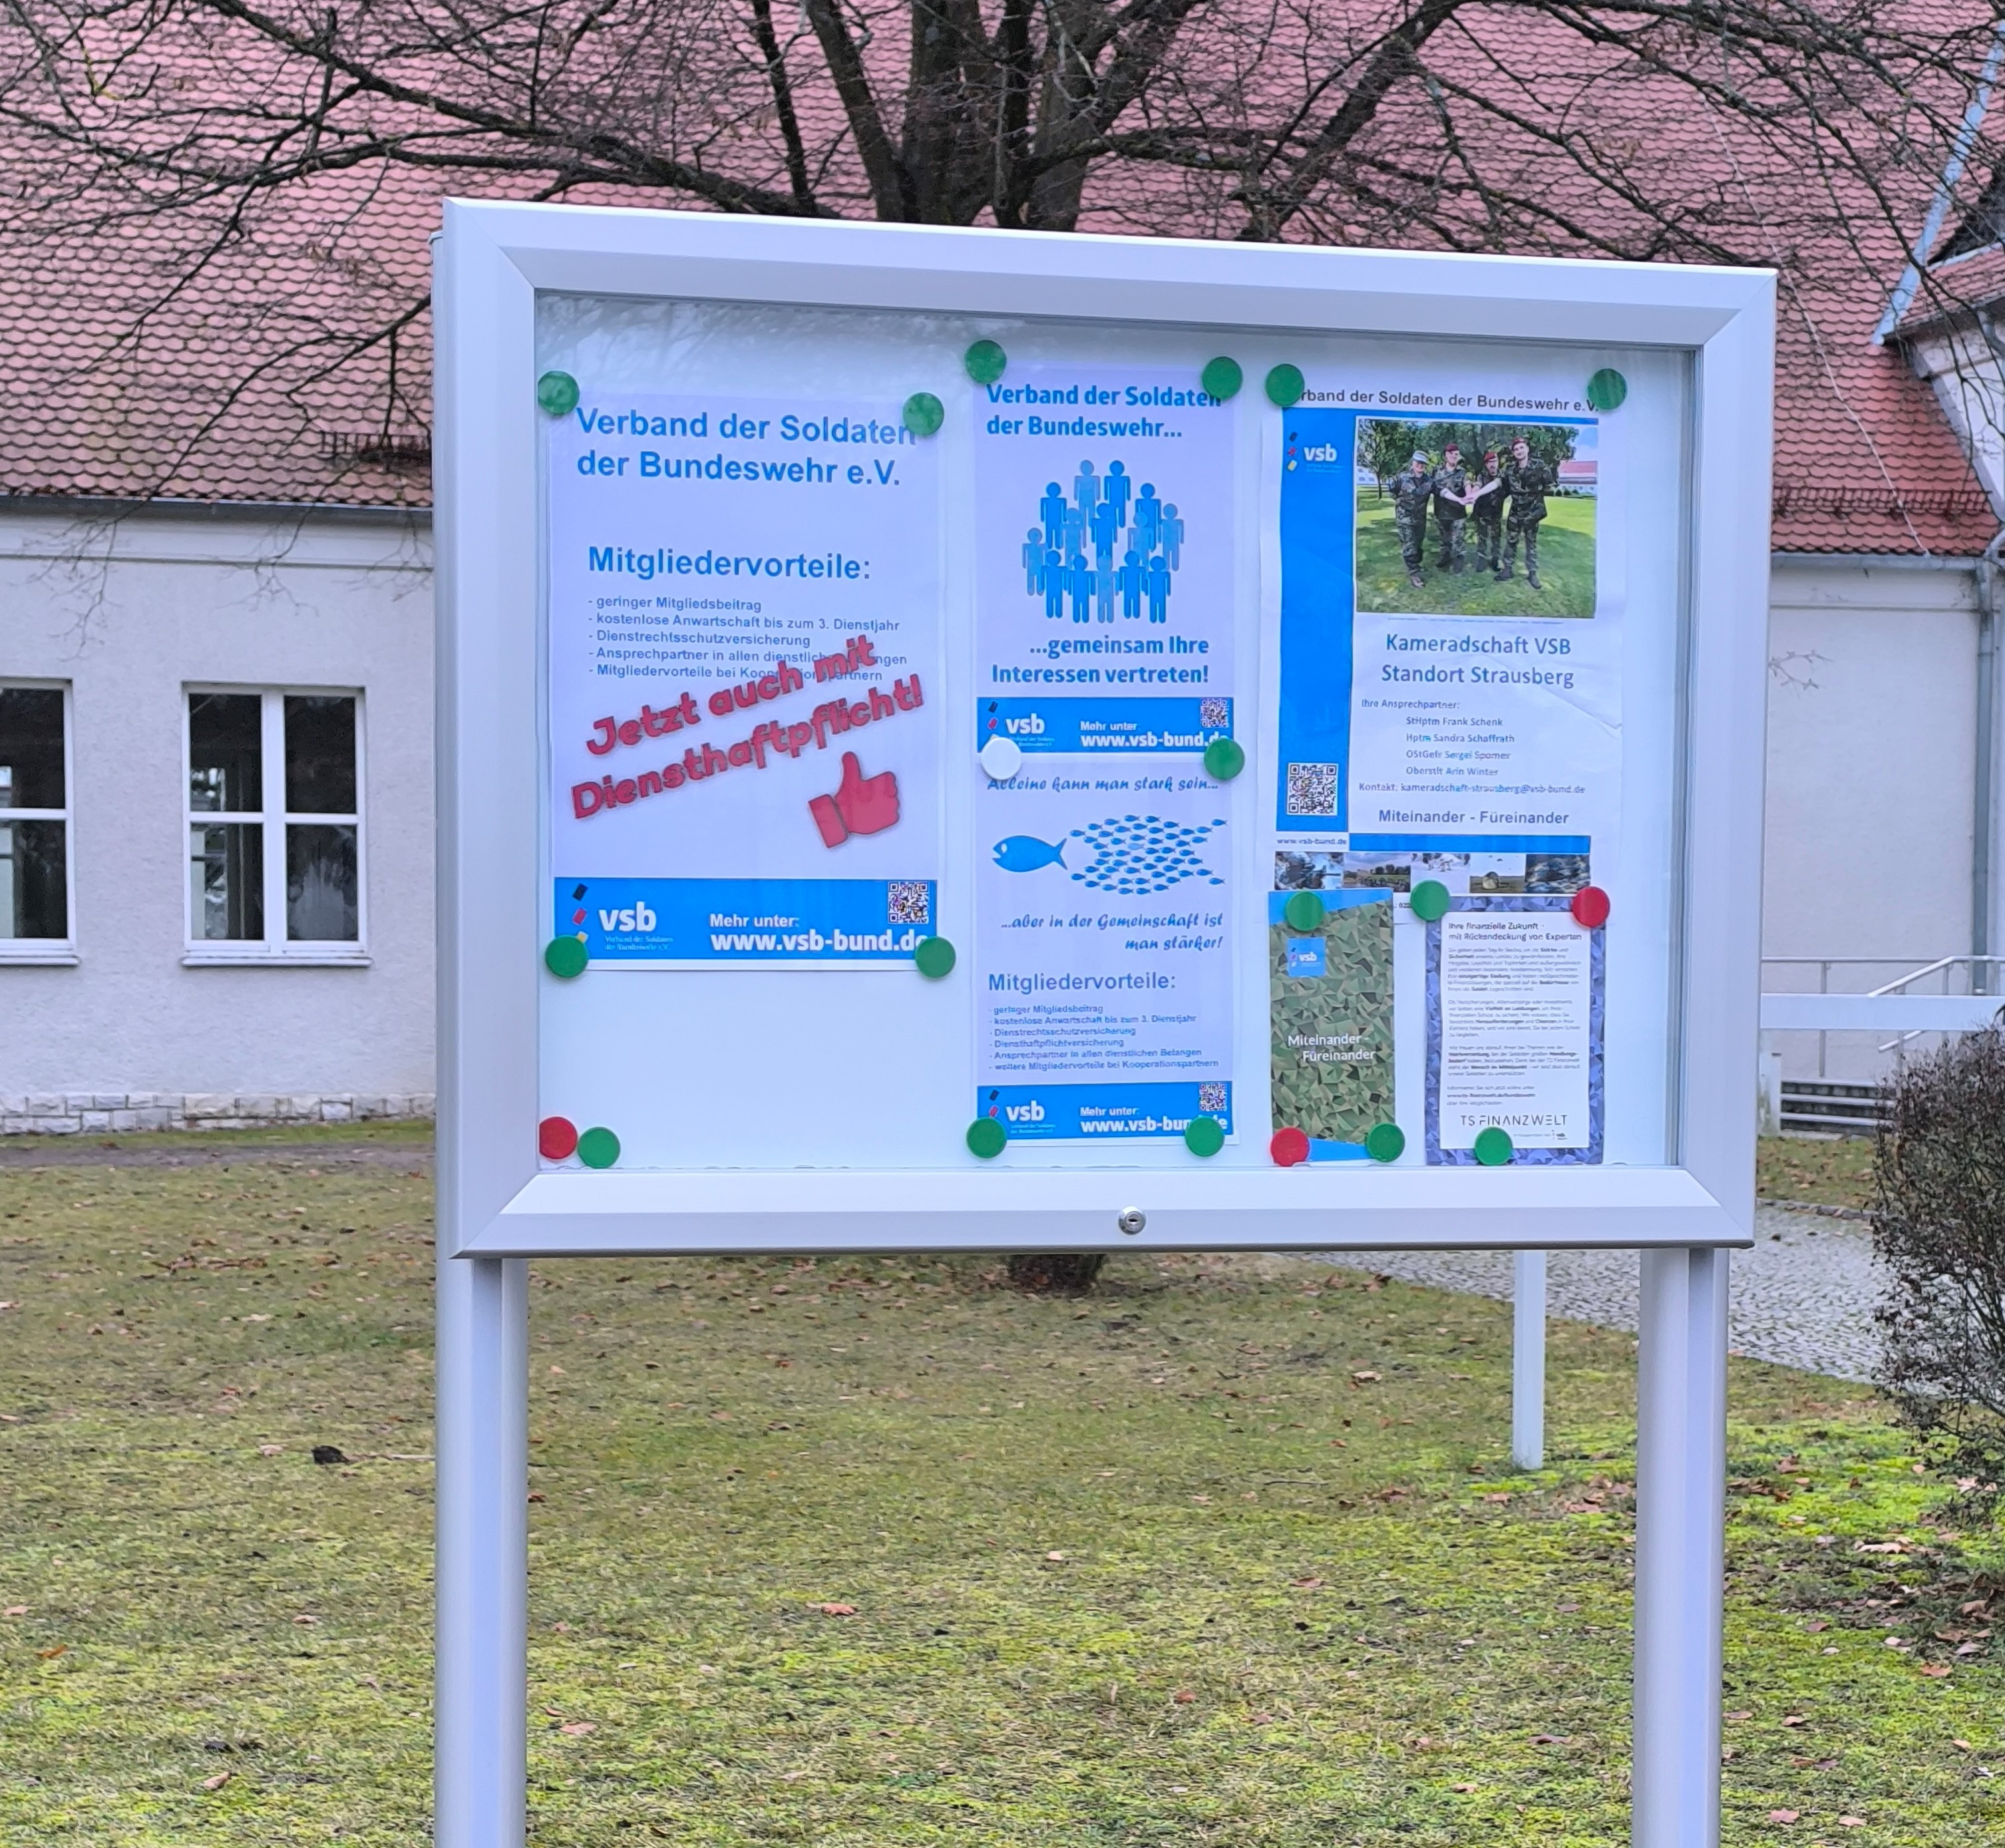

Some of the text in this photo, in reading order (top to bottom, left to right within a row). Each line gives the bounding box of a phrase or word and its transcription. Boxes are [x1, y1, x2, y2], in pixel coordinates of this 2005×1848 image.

[986, 384, 1221, 407] Verband der Soldaten
[1302, 389, 1345, 401] rband
[1350, 390, 1374, 403] der
[1378, 391, 1443, 406] Soldaten
[1448, 393, 1472, 407] der
[1477, 395, 1569, 411] Bundeswehr
[576, 408, 916, 445] Verband der Soldaten
[987, 415, 1182, 437] der Bundeswehr...
[1304, 443, 1337, 462] vsb
[577, 451, 900, 485] der Bundeswehr e.V.
[588, 546, 870, 580] Mitgliedervorteile:
[597, 596, 761, 613] geringer Mitgliedsbeitrag
[597, 613, 900, 634] kostenlose Anwartschaft bis zum 3. Dienstjahr
[597, 630, 811, 648] Dienstrechtsschutzversicherung
[1029, 635, 1209, 659] ...gemeinsam Ihre
[1386, 634, 1571, 655] Kameradschaft VSB
[596, 647, 709, 663] Ansprechpartner
[713, 649, 724, 661] in
[728, 650, 759, 661] allen
[597, 663, 712, 679] Mitgliedervorteile
[716, 666, 735, 677] bei
[992, 665, 1208, 683] Interessen vertreten!
[1381, 664, 1574, 689] Standort Strausberg
[586, 634, 878, 755] Jetzt auch mit
[1005, 713, 1045, 734] vsb
[1080, 721, 1106, 731] Mehr
[1443, 717, 1468, 726] Frank
[1470, 717, 1503, 726] Schenk
[570, 673, 924, 819] Diensthaftpflicht!
[1081, 731, 1229, 747] www.vsb-bund.
[1433, 733, 1465, 742] Sandra
[1467, 734, 1515, 743] Schaffrath
[1052, 777, 1089, 793] kann
[1095, 779, 1129, 792] man
[1134, 777, 1173, 792] stark
[1379, 810, 1465, 823] Miteinander
[1479, 810, 1569, 825] Füreinander
[599, 901, 657, 931] vsb
[710, 914, 799, 928] Mehr unter:
[1049, 914, 1063, 928] in
[1069, 914, 1093, 928] der
[1098, 913, 1198, 930] Gemeinschaft
[1204, 913, 1223, 928] ist
[1125, 939, 1158, 951] man
[988, 972, 1176, 995] Mitgliedervorteile:
[1288, 1034, 1362, 1047] Miteinander
[1303, 1049, 1376, 1063] Füreinander
[1005, 1100, 1045, 1121] vsb
[1080, 1107, 1106, 1117] Mehr
[1081, 1115, 1228, 1133] www.vsb-bune
[1461, 1115, 1567, 1126] TS FINANZWELT
